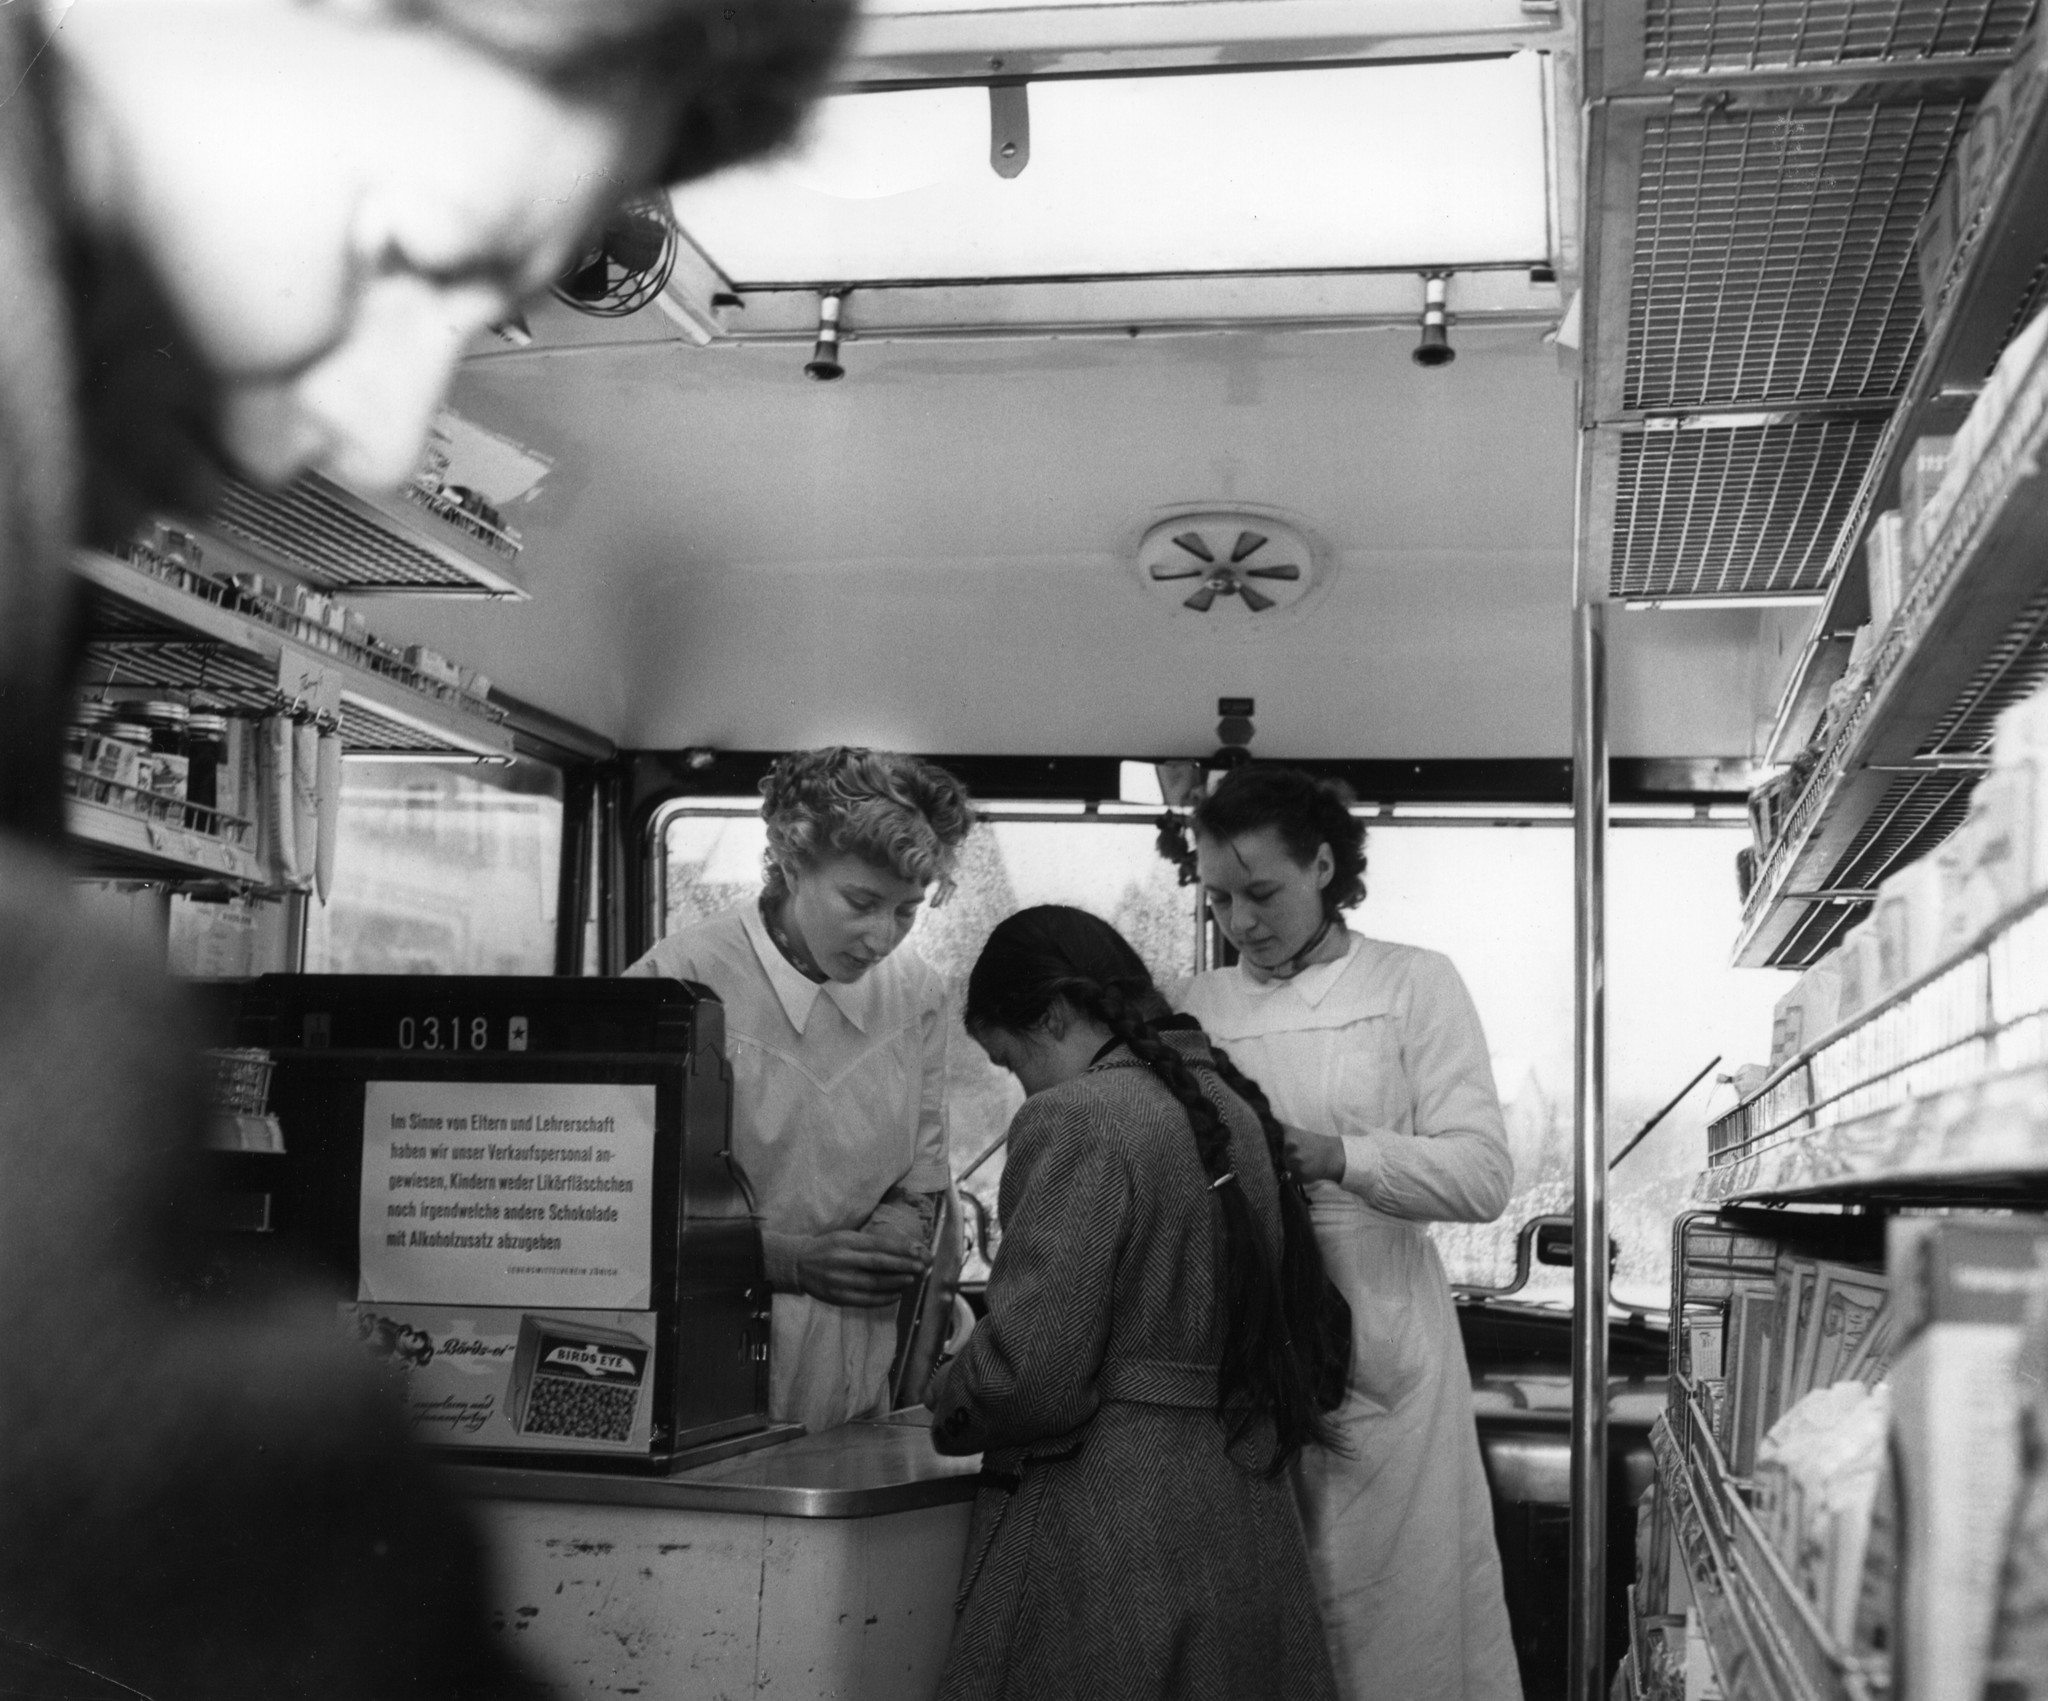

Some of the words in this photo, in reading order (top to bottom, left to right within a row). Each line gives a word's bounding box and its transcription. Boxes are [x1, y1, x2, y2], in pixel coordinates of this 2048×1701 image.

[390, 1113, 406, 1130] Im
[409, 1113, 443, 1130] Sinne
[446, 1117, 468, 1131] von
[471, 1114, 507, 1132] Eltern
[510, 1114, 533, 1132] und
[536, 1115, 615, 1133] Lehrerschaft
[390, 1142, 426, 1159] haben
[430, 1143, 449, 1159] wir
[452, 1147, 486, 1160] unser
[488, 1143, 593, 1164] Verkaufspersonal
[596, 1149, 616, 1162] an-
[389, 1172, 447, 1191] gewiesen,
[449, 1173, 496, 1190] Kindern
[499, 1174, 534, 1191] weder
[537, 1174, 634, 1193] Likörfläschchen
[387, 1202, 416, 1218] noch
[420, 1201, 499, 1221] irgendwelche
[503, 1204, 545, 1220] andere
[549, 1204, 618, 1222] Schokolade
[386, 1230, 406, 1247] mit
[409, 1231, 494, 1249] Alkoholzusatz
[497, 1234, 562, 1252] abzugeben
[557, 1349, 597, 1364] BIRDS
[600, 1355, 623, 1368] EYE
